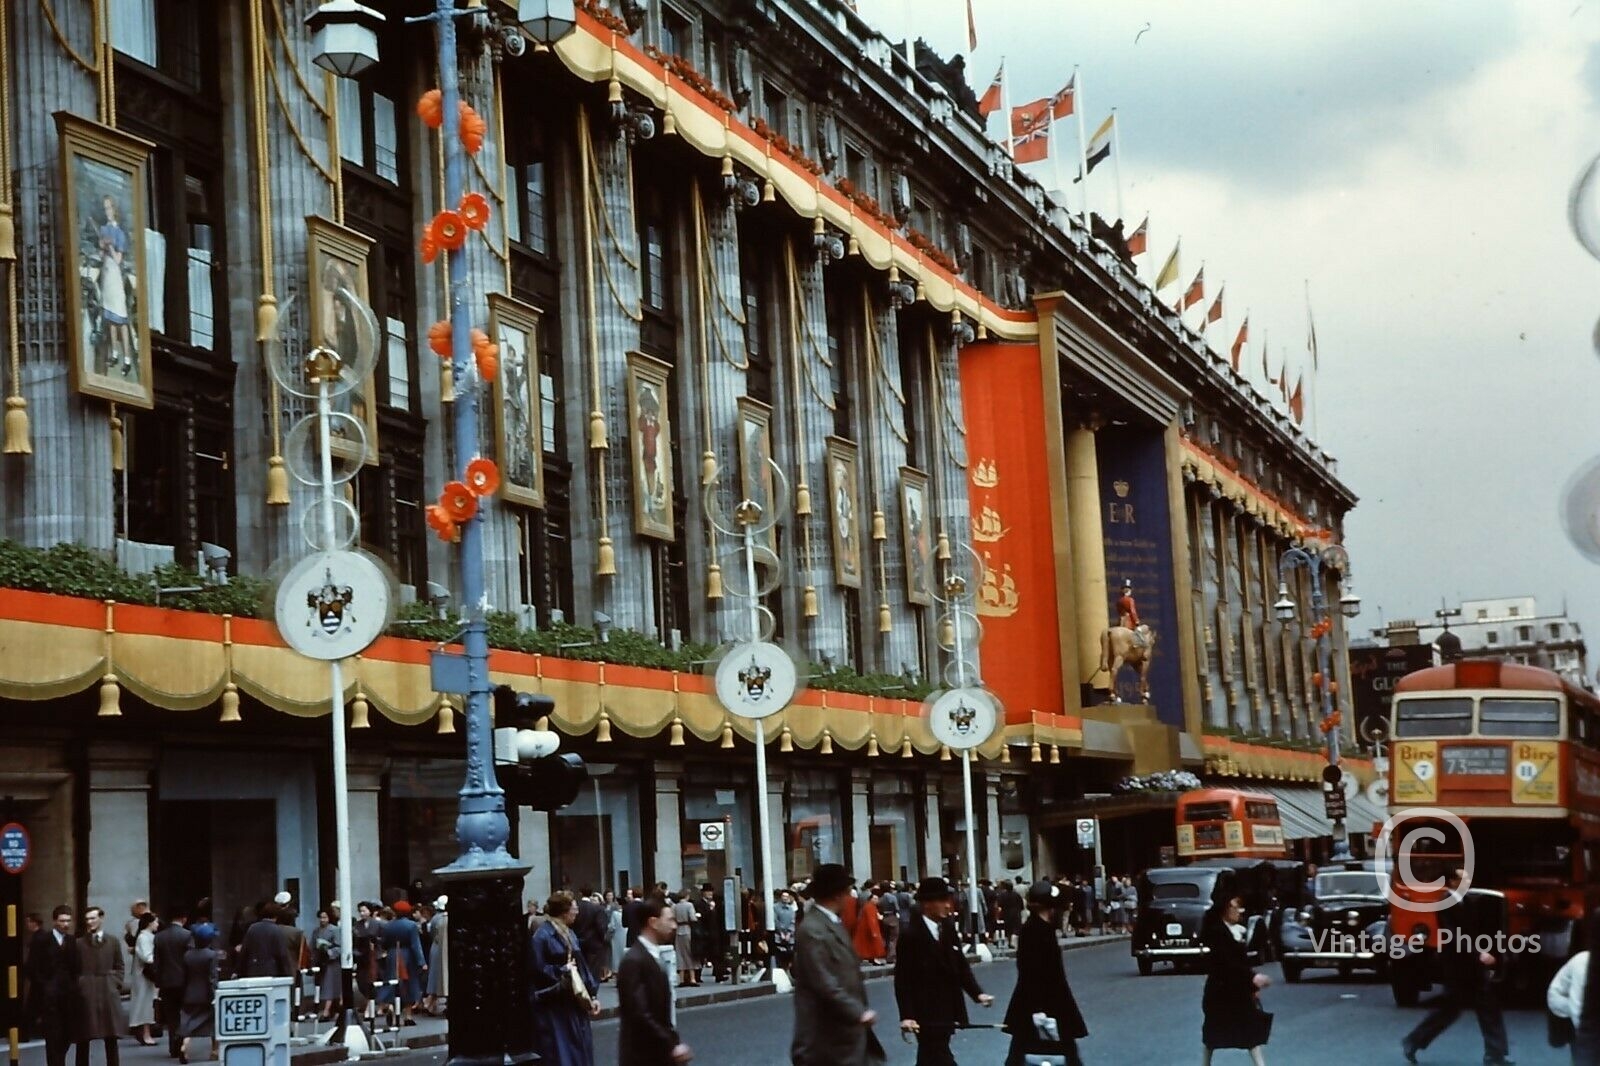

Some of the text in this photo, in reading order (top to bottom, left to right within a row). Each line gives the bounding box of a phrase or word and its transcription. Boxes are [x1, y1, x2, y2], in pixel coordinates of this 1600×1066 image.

[1419, 765, 1429, 777] 7
[1447, 759, 1467, 775] 73
[225, 999, 262, 1014] KEEP
[225, 1016, 262, 1032] LEFT
